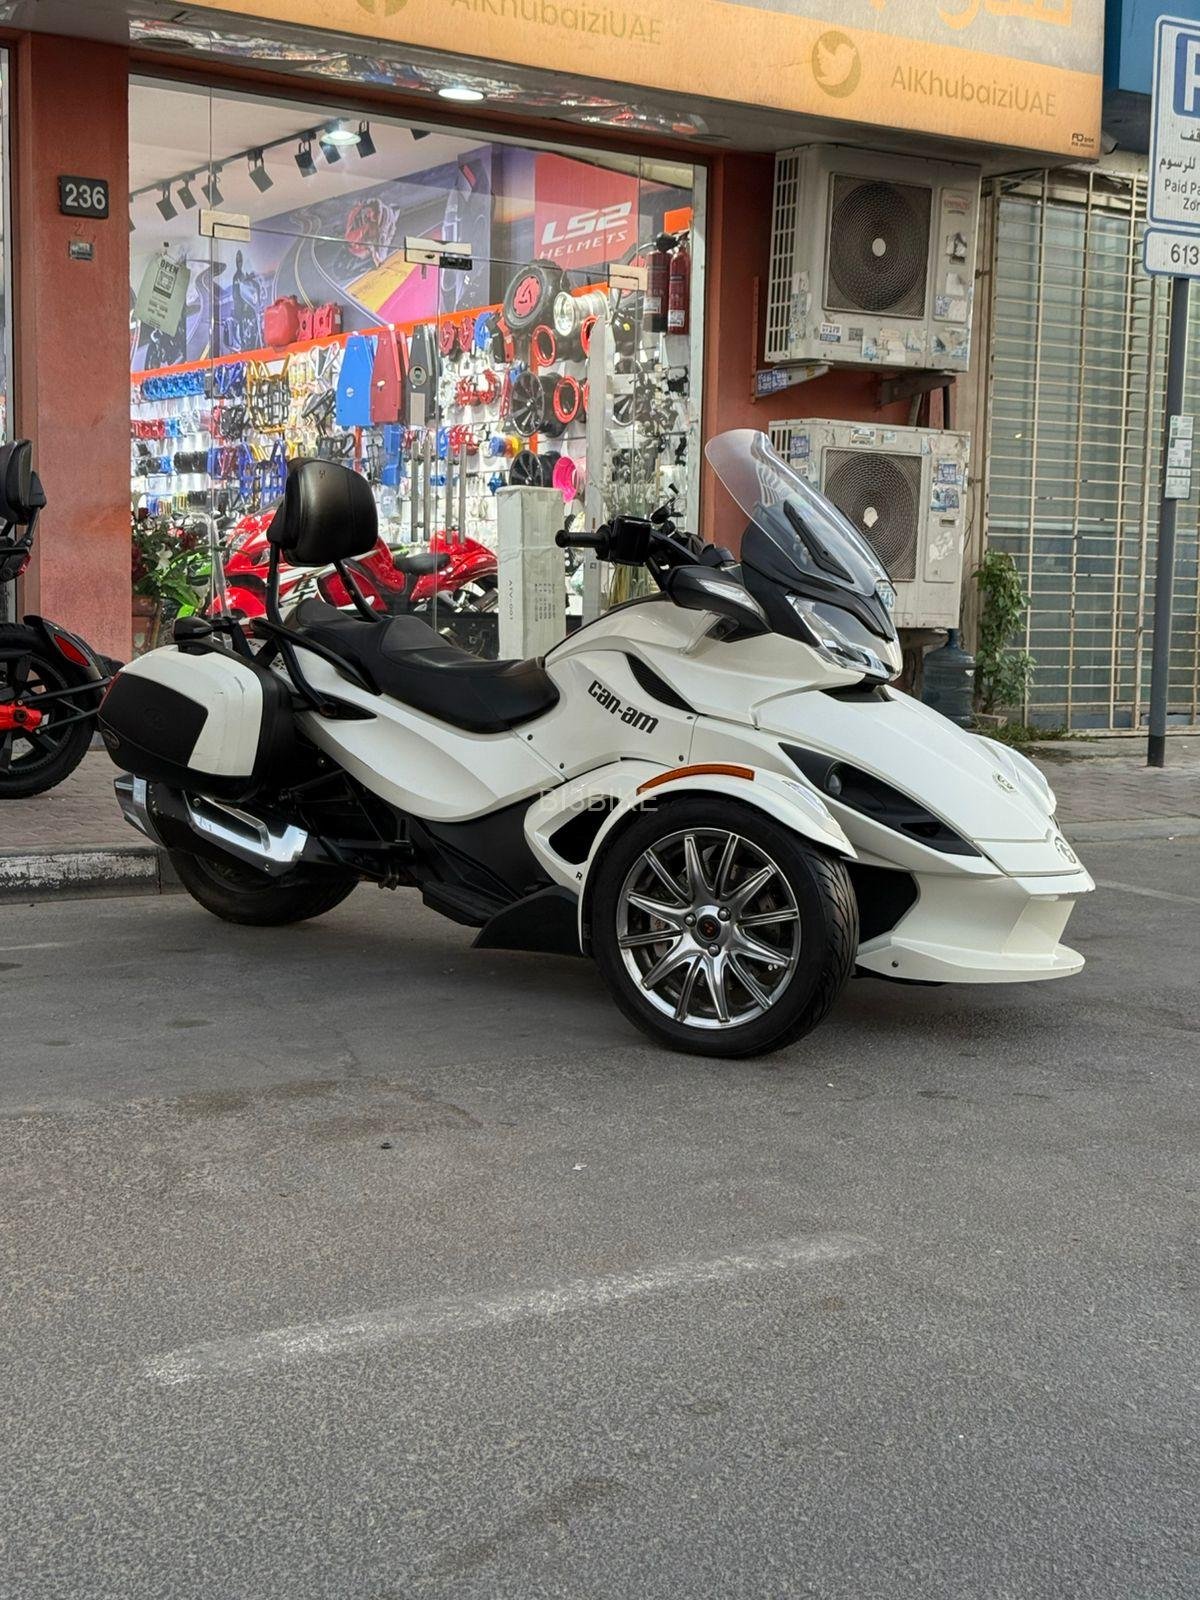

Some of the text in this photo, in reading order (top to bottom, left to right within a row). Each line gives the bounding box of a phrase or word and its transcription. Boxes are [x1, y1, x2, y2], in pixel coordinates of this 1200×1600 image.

[891, 65, 1057, 118] AlKhubaiziUAE
[65, 183, 106, 210] 236
[1164, 178, 1188, 194] Paid
[541, 201, 632, 245] LS2
[539, 230, 628, 260] HELMETS
[1170, 243, 1199, 266] 613
[160, 259, 180, 275] OPEN
[587, 680, 659, 734] can-am
